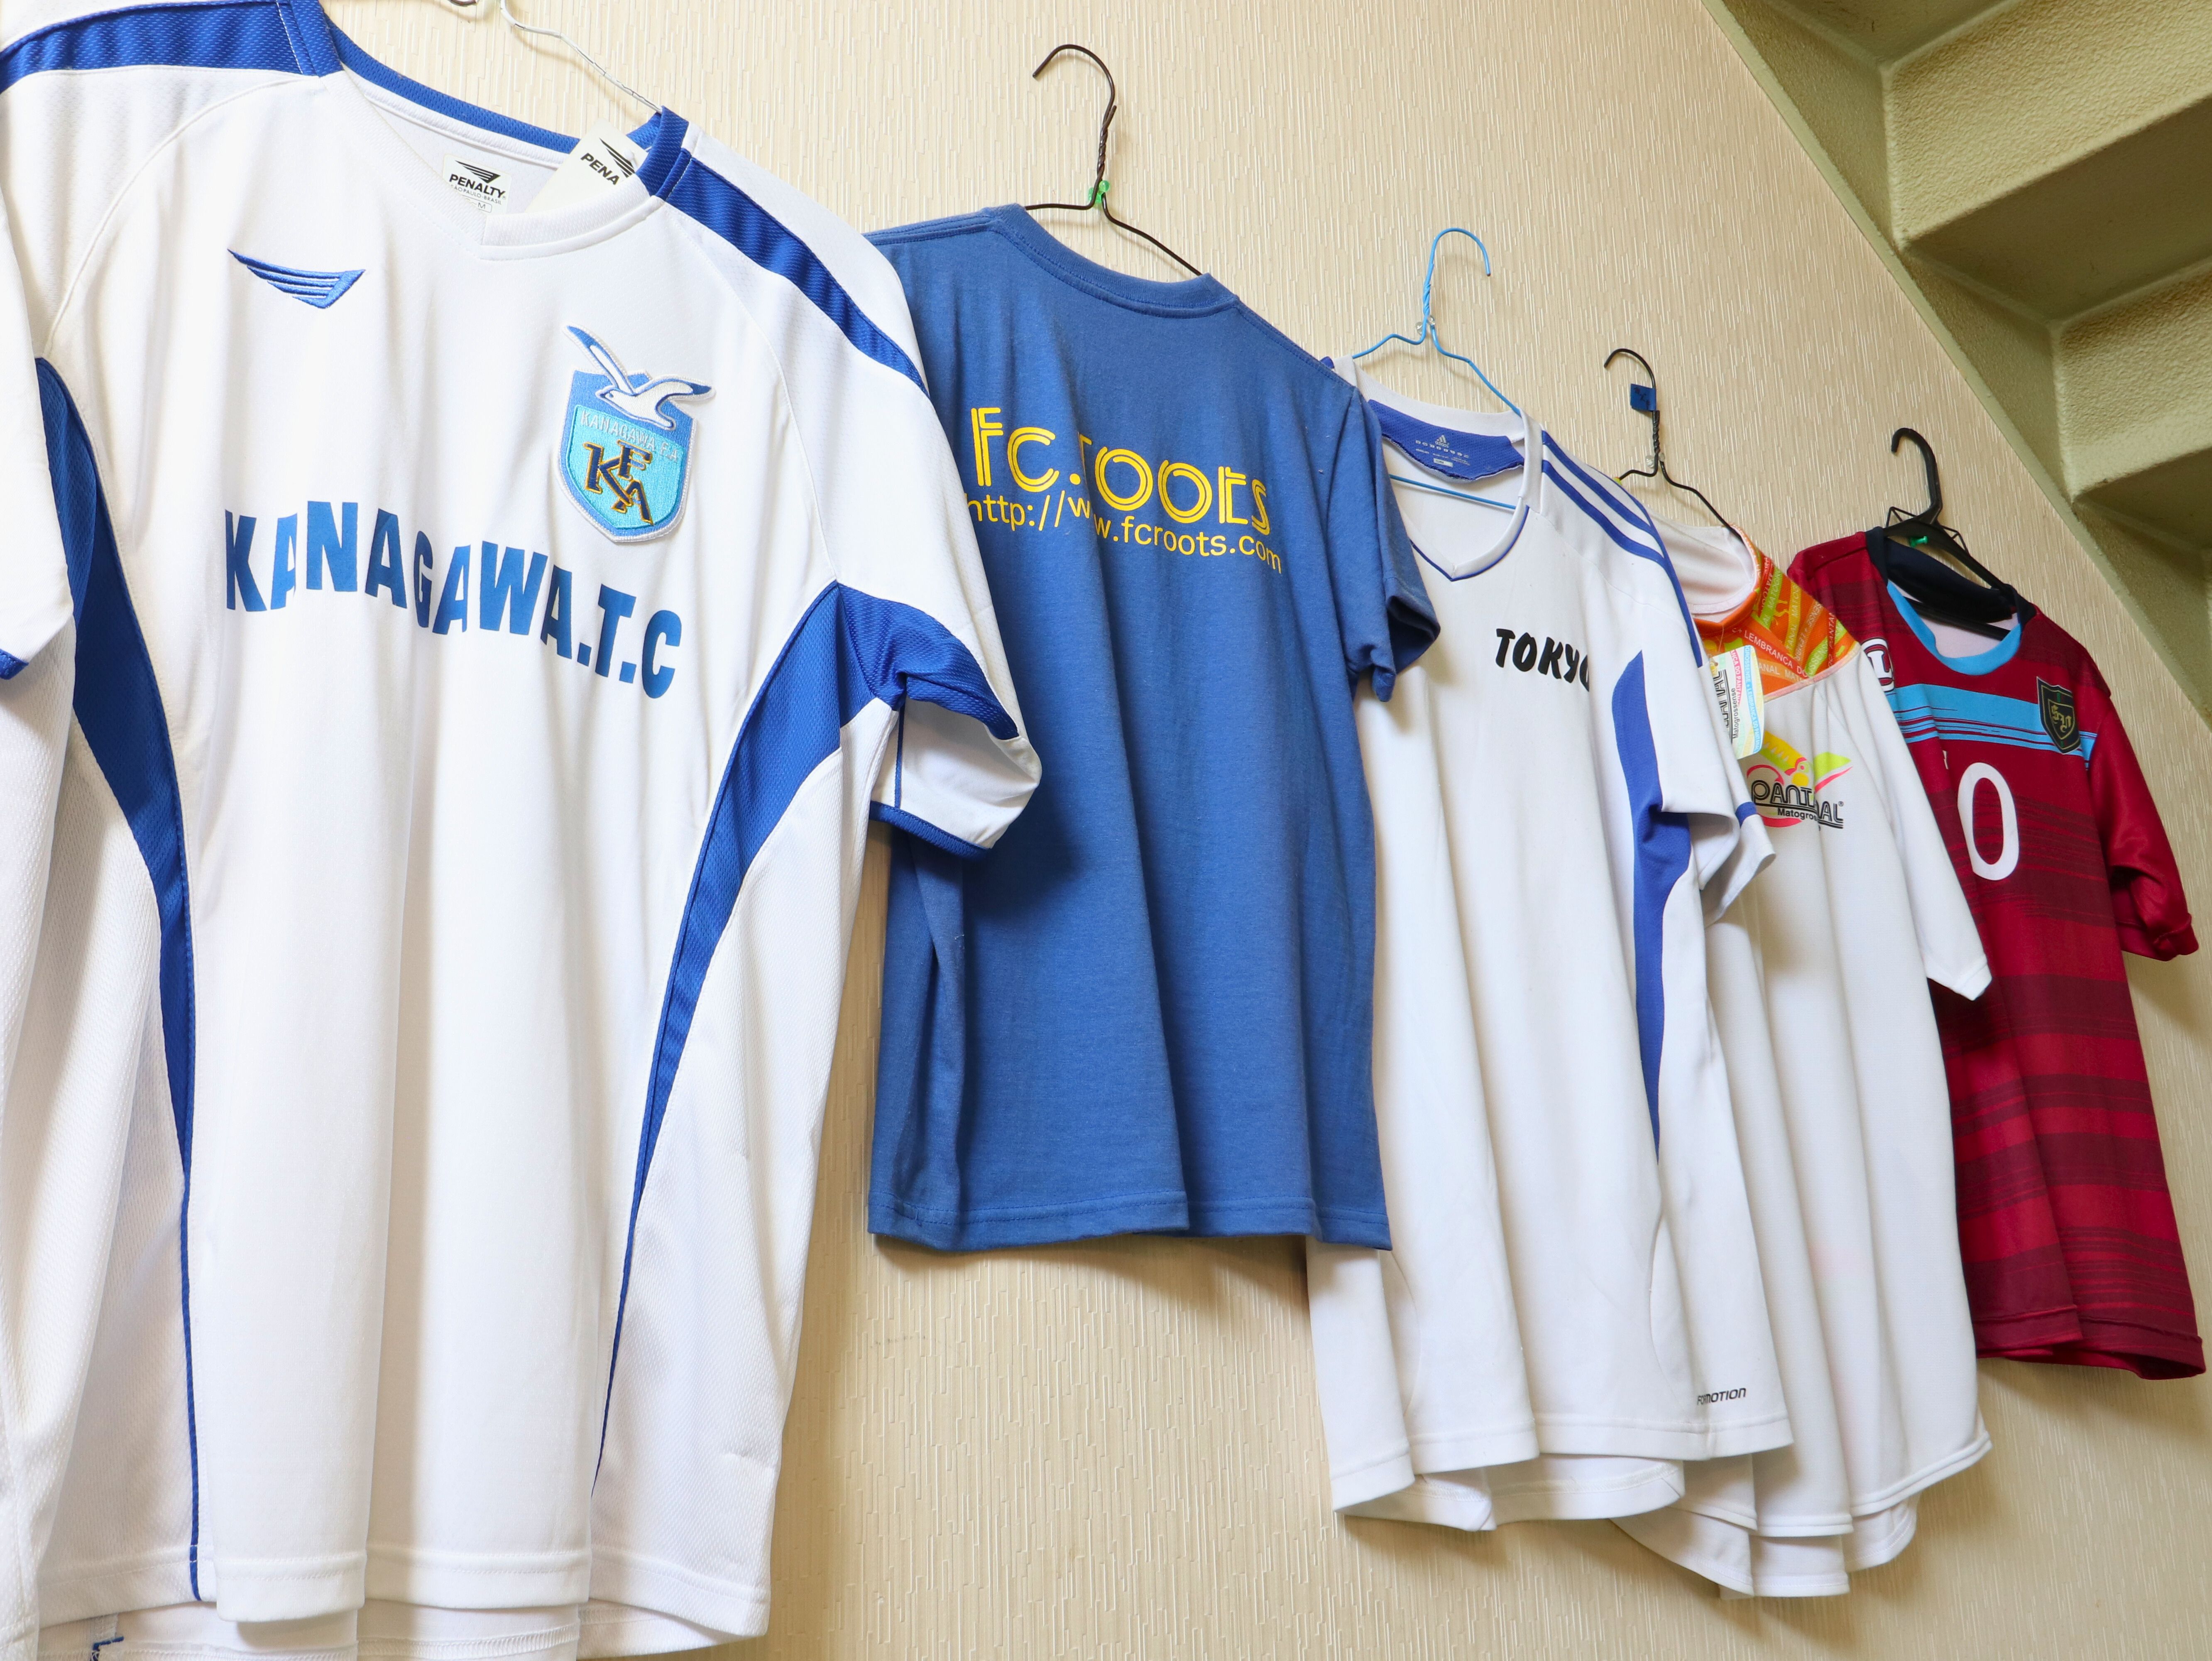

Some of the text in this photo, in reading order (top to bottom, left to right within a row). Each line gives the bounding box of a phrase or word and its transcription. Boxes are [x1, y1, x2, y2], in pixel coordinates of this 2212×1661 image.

[449, 174, 506, 198] PENALTY
[580, 152, 620, 185] PENA
[581, 409, 656, 451] KANAGAWA
[964, 489, 1282, 574] http://ww.fcroots.com
[225, 500, 682, 699] KANAGAWA.T.C
[1735, 665, 1740, 675] DO
[1744, 630, 1793, 669] LEMBRANCA
[1731, 687, 1740, 739] Matogrossense
[1956, 761, 2020, 881] 0
